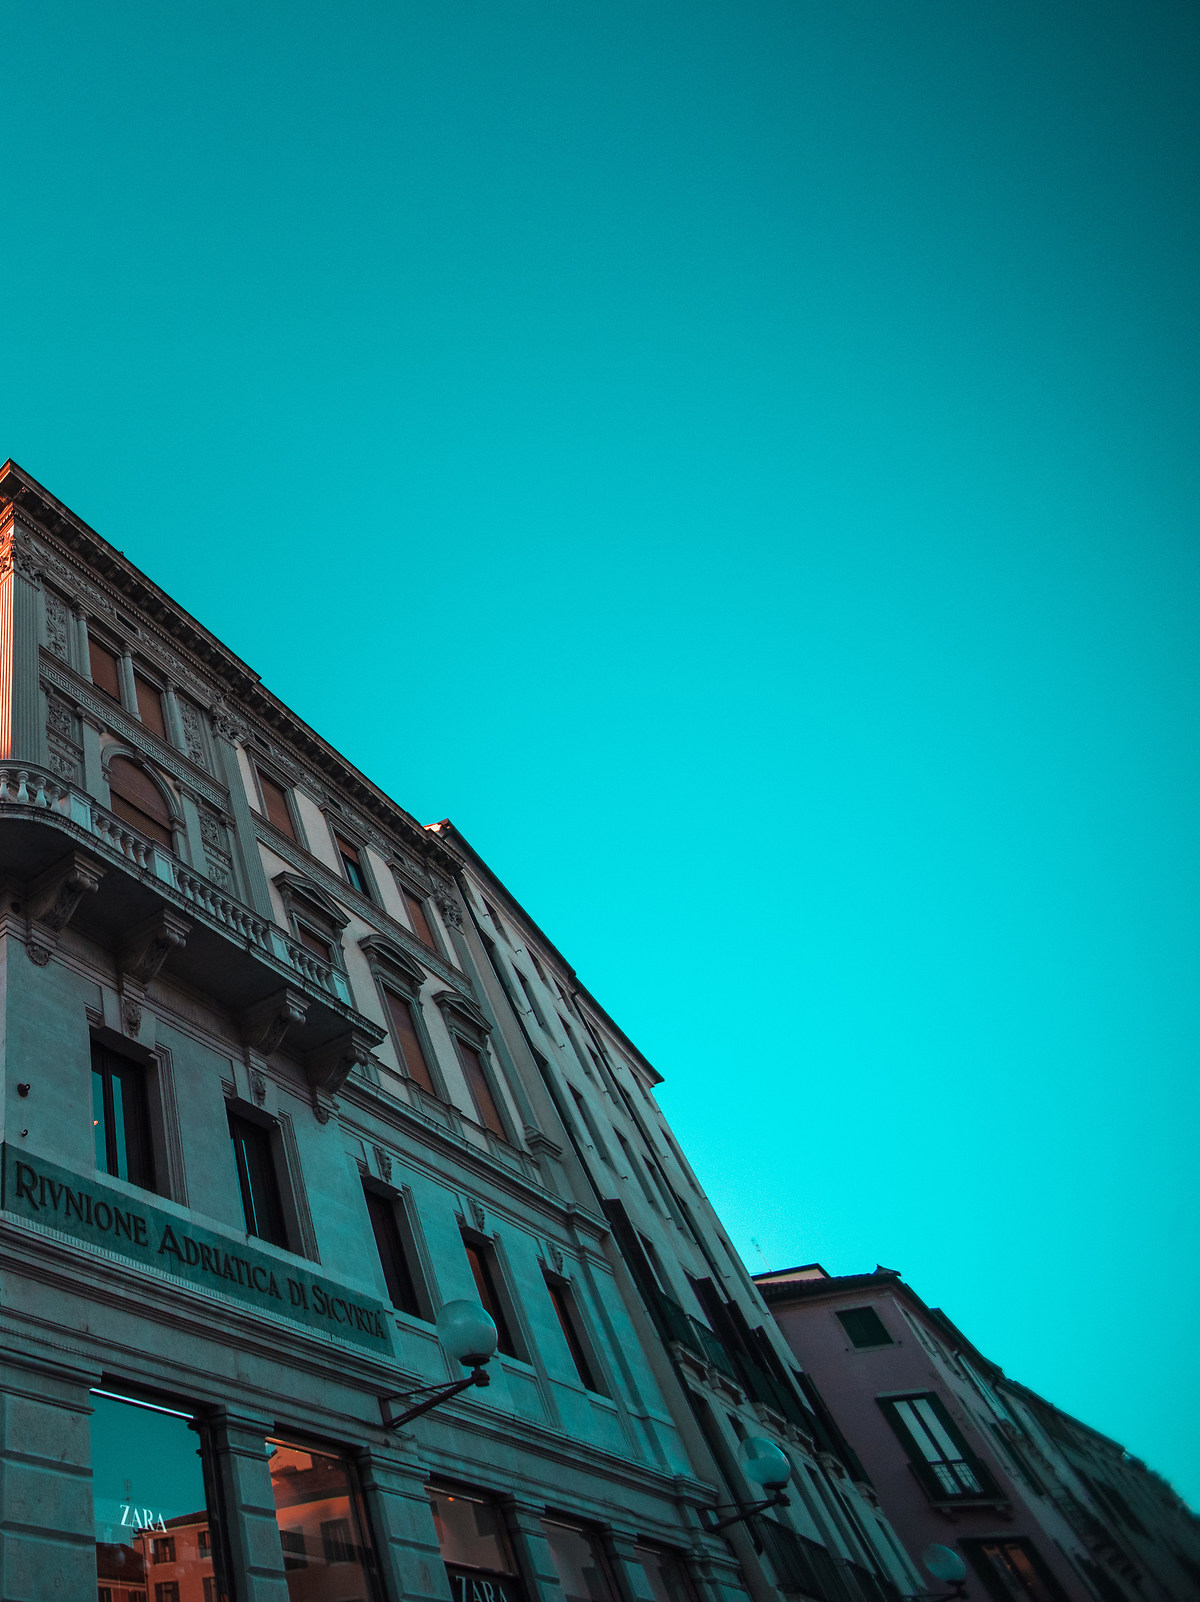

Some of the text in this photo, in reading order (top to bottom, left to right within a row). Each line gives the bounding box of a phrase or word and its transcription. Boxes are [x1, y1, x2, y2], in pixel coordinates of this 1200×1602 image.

[15, 1160, 149, 1248] RIVNIONE
[157, 1224, 283, 1300] ADRIATICA
[287, 1278, 310, 1310] DI
[120, 1504, 167, 1533] ZARA
